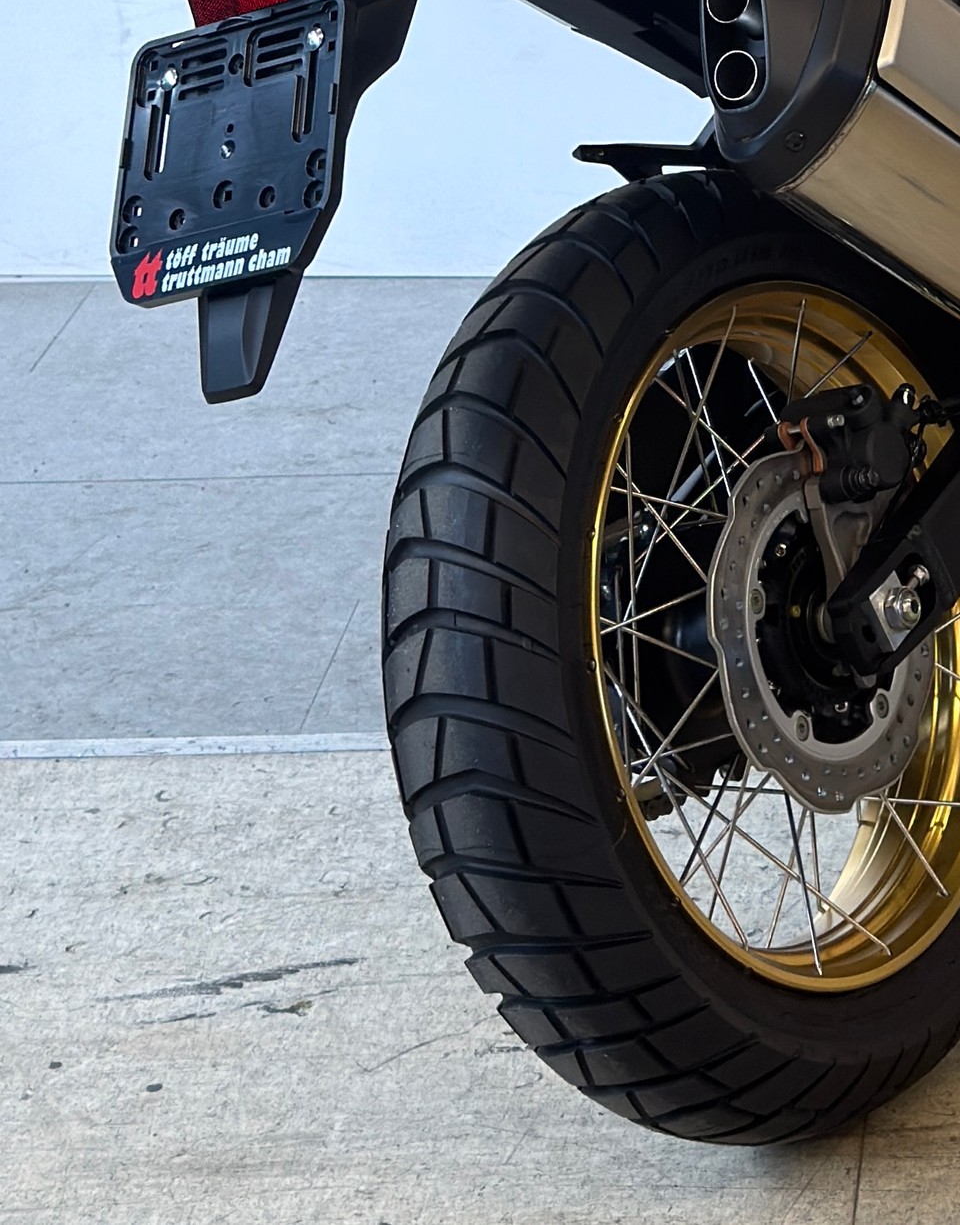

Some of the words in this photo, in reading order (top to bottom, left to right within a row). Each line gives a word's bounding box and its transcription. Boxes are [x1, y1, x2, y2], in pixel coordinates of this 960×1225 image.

[161, 257, 245, 293] truttmann
[248, 246, 292, 272] cham
[165, 243, 199, 271] töff
[201, 232, 259, 262] träume
